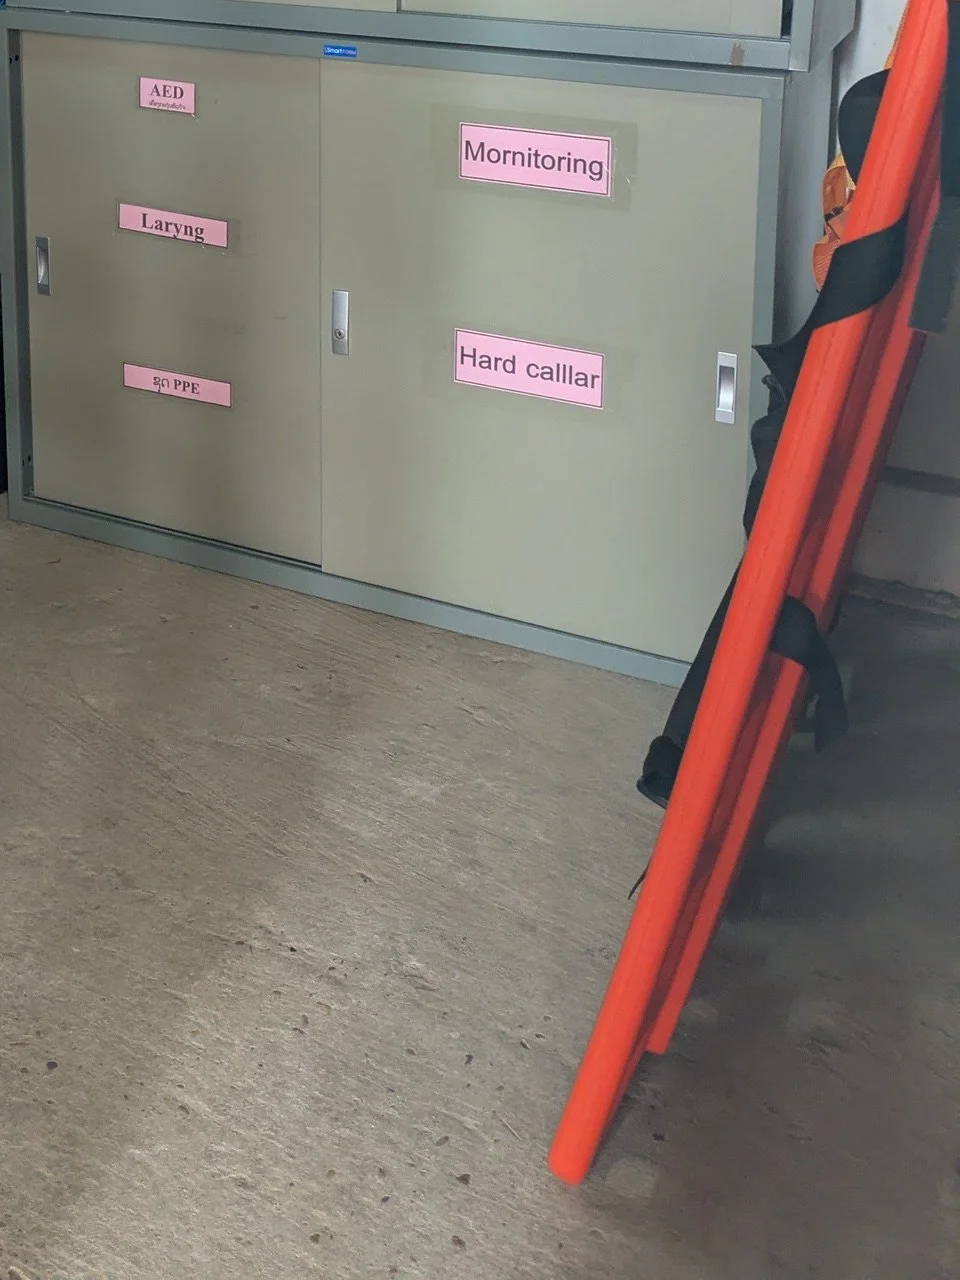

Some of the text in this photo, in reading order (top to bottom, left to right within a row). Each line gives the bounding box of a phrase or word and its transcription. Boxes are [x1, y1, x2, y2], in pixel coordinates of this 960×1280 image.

[150, 83, 184, 99] AED
[464, 139, 605, 182] Mornitoring
[141, 212, 206, 242] Laryng
[460, 345, 601, 390] Hard calllar
[173, 378, 201, 395] PPE
